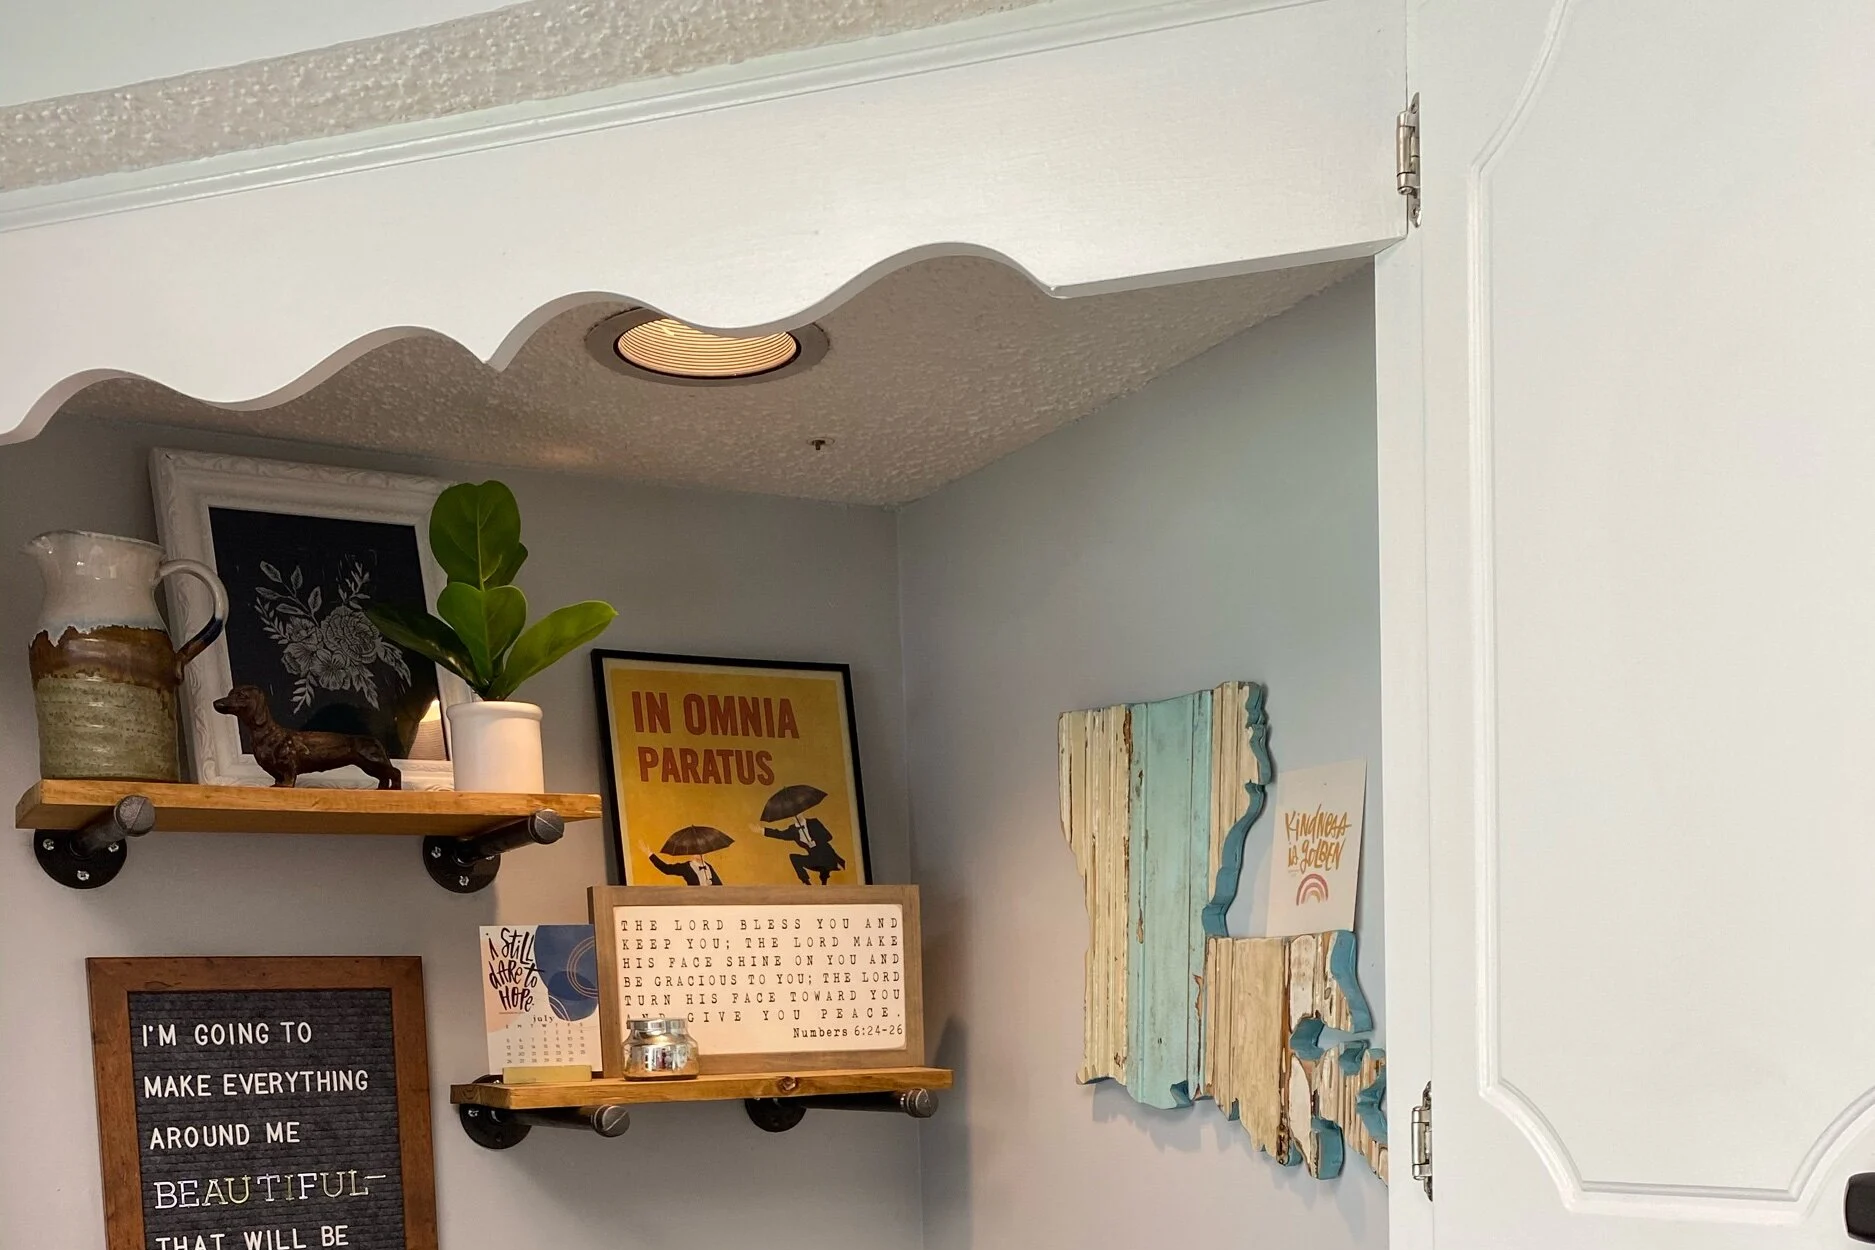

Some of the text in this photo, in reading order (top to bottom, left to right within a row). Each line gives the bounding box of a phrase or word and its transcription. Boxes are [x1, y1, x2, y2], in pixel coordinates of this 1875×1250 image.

[632, 691, 800, 739] IN OMNIA
[637, 746, 775, 786] PARATUS
[621, 917, 897, 931] THE LORD BLESS YOU AND
[622, 935, 898, 950] KEEP YOU; THE LORD MAKE
[622, 953, 900, 969] HIS FACE SHINE ON YOU AND
[624, 971, 900, 987] BE GRACIOUS TO YOU; THE LORD
[624, 989, 900, 1006] TURN HIS FACE TOWARD YOU
[533, 1015, 555, 1023] july
[687, 1007, 900, 1023] GIVE YOU PEACE.
[142, 1021, 312, 1047] I'M GOING TO
[793, 1024, 903, 1038] Numbers 6:24-26
[144, 1069, 368, 1099] MAKE EVERYTHING
[150, 1121, 300, 1150] AROUND ME
[320, 1225, 349, 1248] BE
